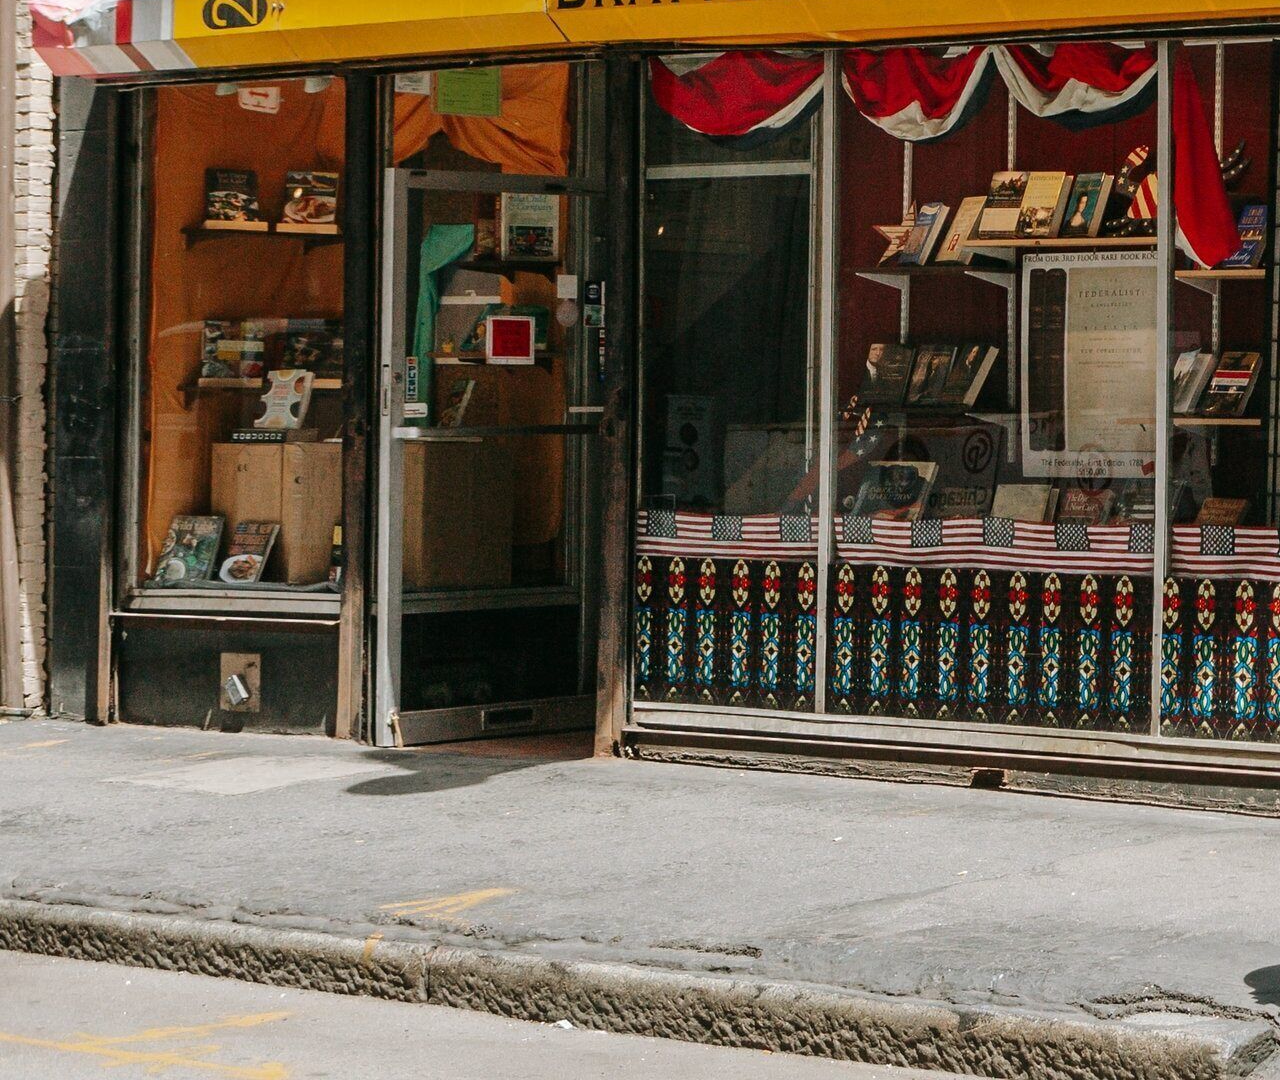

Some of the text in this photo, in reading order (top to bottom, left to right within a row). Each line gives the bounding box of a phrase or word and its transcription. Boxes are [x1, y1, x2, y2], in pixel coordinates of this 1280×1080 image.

[1024, 252, 1138, 263] FROM OUR 3RD FLOOR RARE BOOK
[1041, 459, 1053, 467] The
